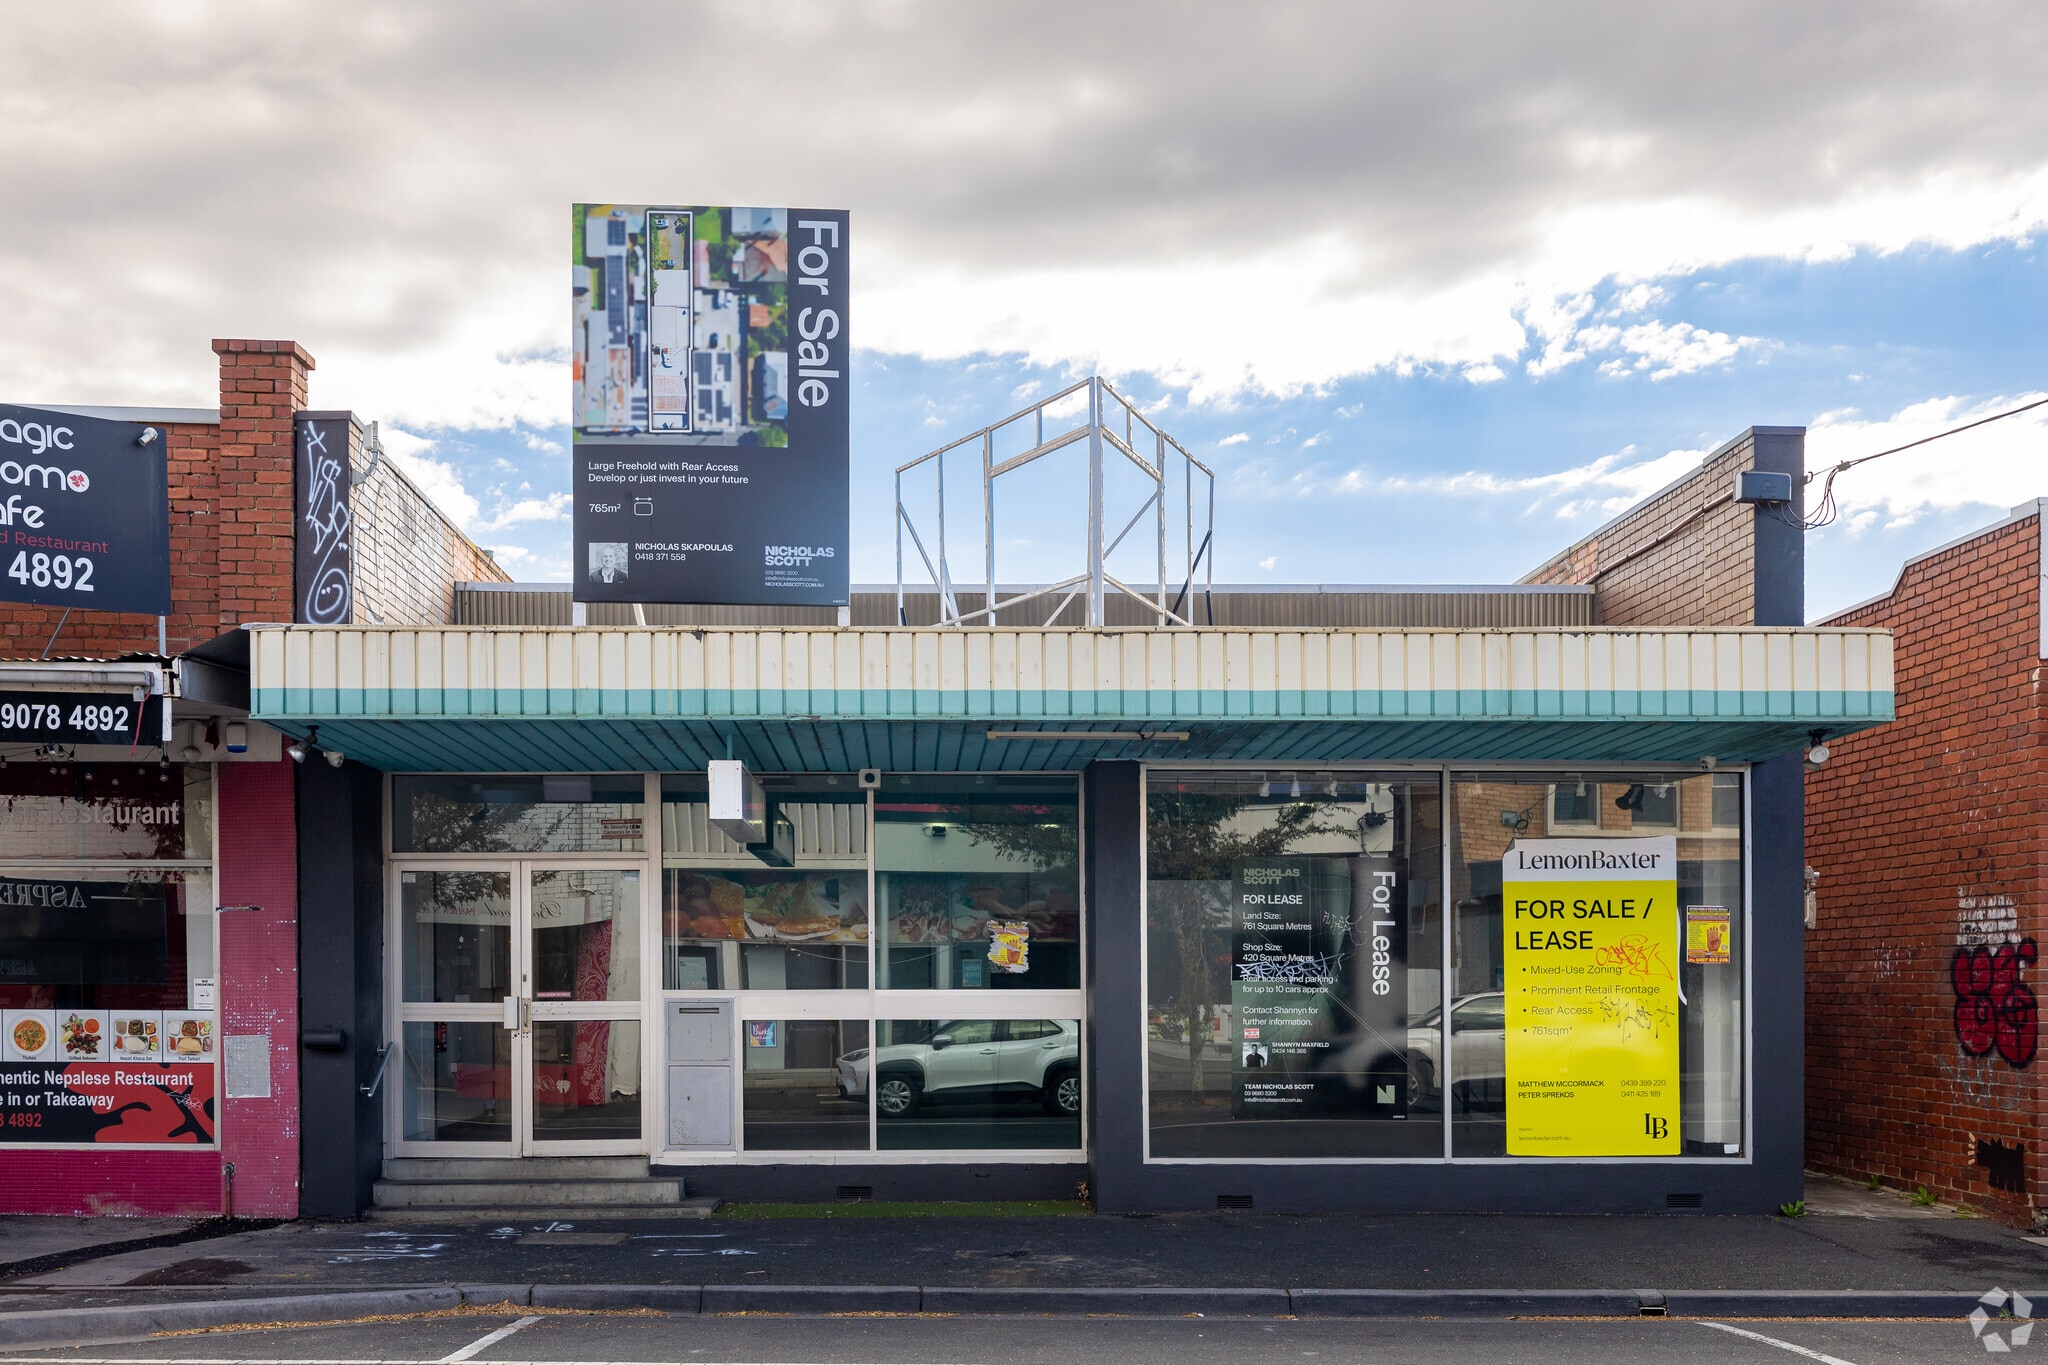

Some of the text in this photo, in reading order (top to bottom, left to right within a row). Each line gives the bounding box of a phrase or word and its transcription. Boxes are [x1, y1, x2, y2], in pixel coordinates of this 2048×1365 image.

[798, 220, 840, 407] For Sale
[588, 462, 738, 472] Large Freehold with Rear Access
[588, 474, 626, 484] Develop
[640, 474, 656, 484] just
[659, 474, 686, 482] invest
[688, 474, 696, 482] in
[698, 476, 720, 484] your
[722, 475, 748, 484] future
[15, 532, 109, 554] Restaurant
[635, 543, 734, 552] NICHOLAS SKAPOULAS
[765, 546, 835, 558] NICHOLAS
[765, 556, 812, 566] SCOTT
[8, 551, 94, 592] 4892
[1, 704, 128, 732] 9078 4892
[51, 801, 180, 825] Restaurant
[1518, 850, 1660, 870] LemonBaxter
[1243, 868, 1300, 878] NICHOLAS
[1243, 876, 1281, 885] SCOTT
[1243, 894, 1303, 905] FOR LEASE
[1514, 898, 1654, 920] FOR SALE /
[1242, 912, 1282, 920] Land Size:
[1242, 922, 1312, 932] 761 Square Metres
[1372, 871, 1396, 996] For Lease
[1514, 930, 1594, 950] LEASE
[1242, 943, 1282, 953] Shop Size:
[1260, 954, 1286, 964] Square
[1288, 954, 1314, 962] Metres
[1530, 965, 1622, 976] Mixed-Use Zoning
[1242, 974, 1261, 982] Rear
[1289, 974, 1304, 983] and
[1304, 974, 1334, 984] parking
[1242, 986, 1252, 994] for
[1254, 987, 1264, 996] up
[1275, 986, 1284, 994] 10
[1302, 987, 1328, 996] approx
[1530, 985, 1660, 996] Prominent Retail Frontage
[1242, 1006, 1318, 1016] Contact Shannyn for
[1531, 1006, 1593, 1015] Rear Access
[1242, 1018, 1312, 1026] further information.
[44, 1071, 110, 1088] Nepalese
[115, 1071, 194, 1086] Restaurant
[8, 1092, 20, 1106] in
[25, 1094, 40, 1106] or
[44, 1092, 114, 1110] Takeaway
[8, 1113, 42, 1128] 4892
[1644, 1113, 1668, 1139] LB
